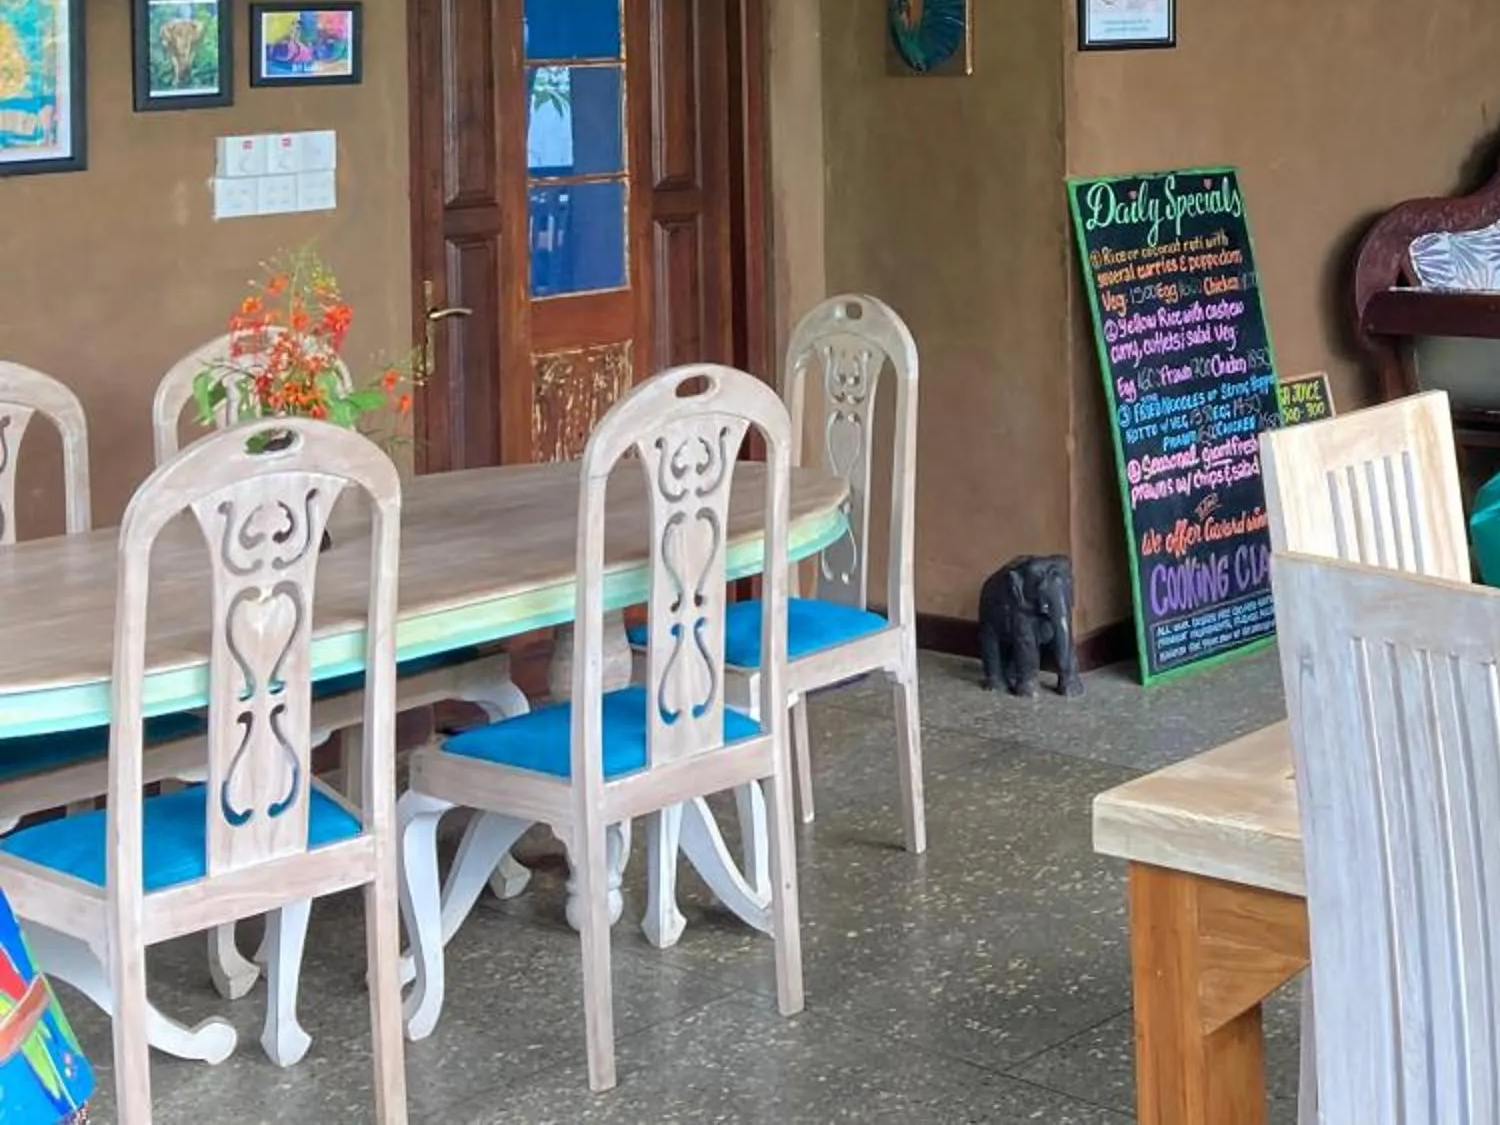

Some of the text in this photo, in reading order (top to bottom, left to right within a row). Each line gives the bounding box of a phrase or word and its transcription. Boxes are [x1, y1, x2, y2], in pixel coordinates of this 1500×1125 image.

[1086, 174, 1242, 248] Daily Specials
[1205, 229, 1230, 248] with
[1156, 282, 1179, 305] Egg
[1203, 274, 1240, 296] Chicken
[1158, 306, 1183, 328] Rice
[1182, 300, 1205, 323] with
[1205, 298, 1246, 321] cashew
[1116, 375, 1138, 404] Egg
[1160, 363, 1193, 387] Prawn
[1291, 379, 1322, 403] JUICE
